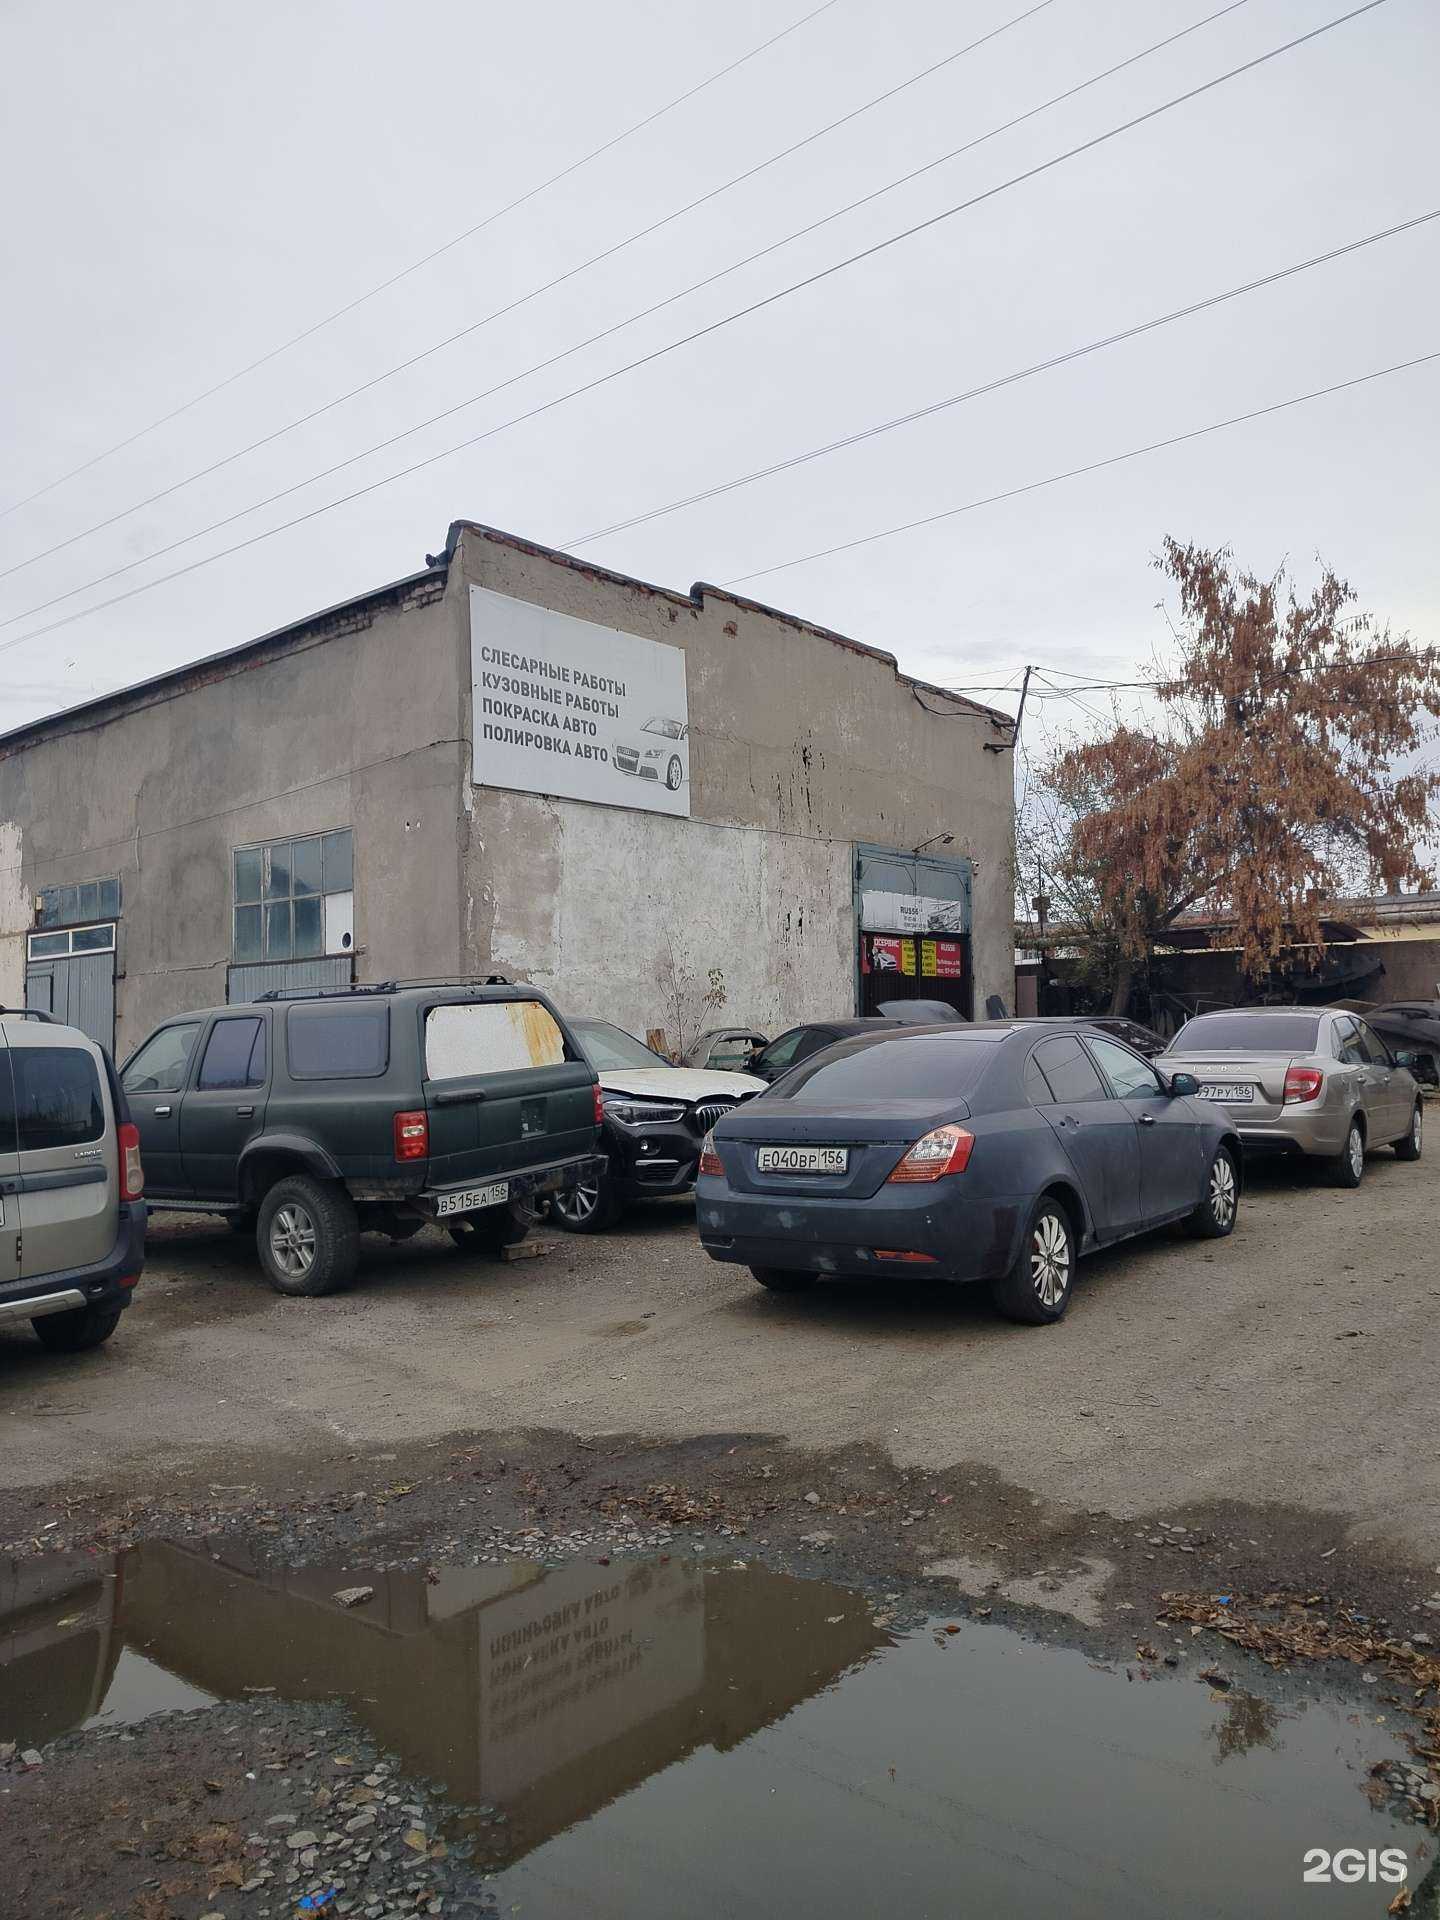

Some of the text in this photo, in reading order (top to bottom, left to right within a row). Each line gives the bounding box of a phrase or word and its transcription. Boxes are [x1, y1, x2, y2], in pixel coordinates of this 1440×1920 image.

[481, 646, 626, 696] СЛЕСАРНЫЕ РАБОТЫ
[481, 671, 619, 718] КУЗОВНЫЕ РАБОТЫ
[482, 697, 597, 737] ПОКРАСКА АВТО
[483, 723, 608, 762] ПОЛИРОВКА АВТО
[820, 1150, 844, 1164] 156
[490, 1184, 507, 1197] 156
